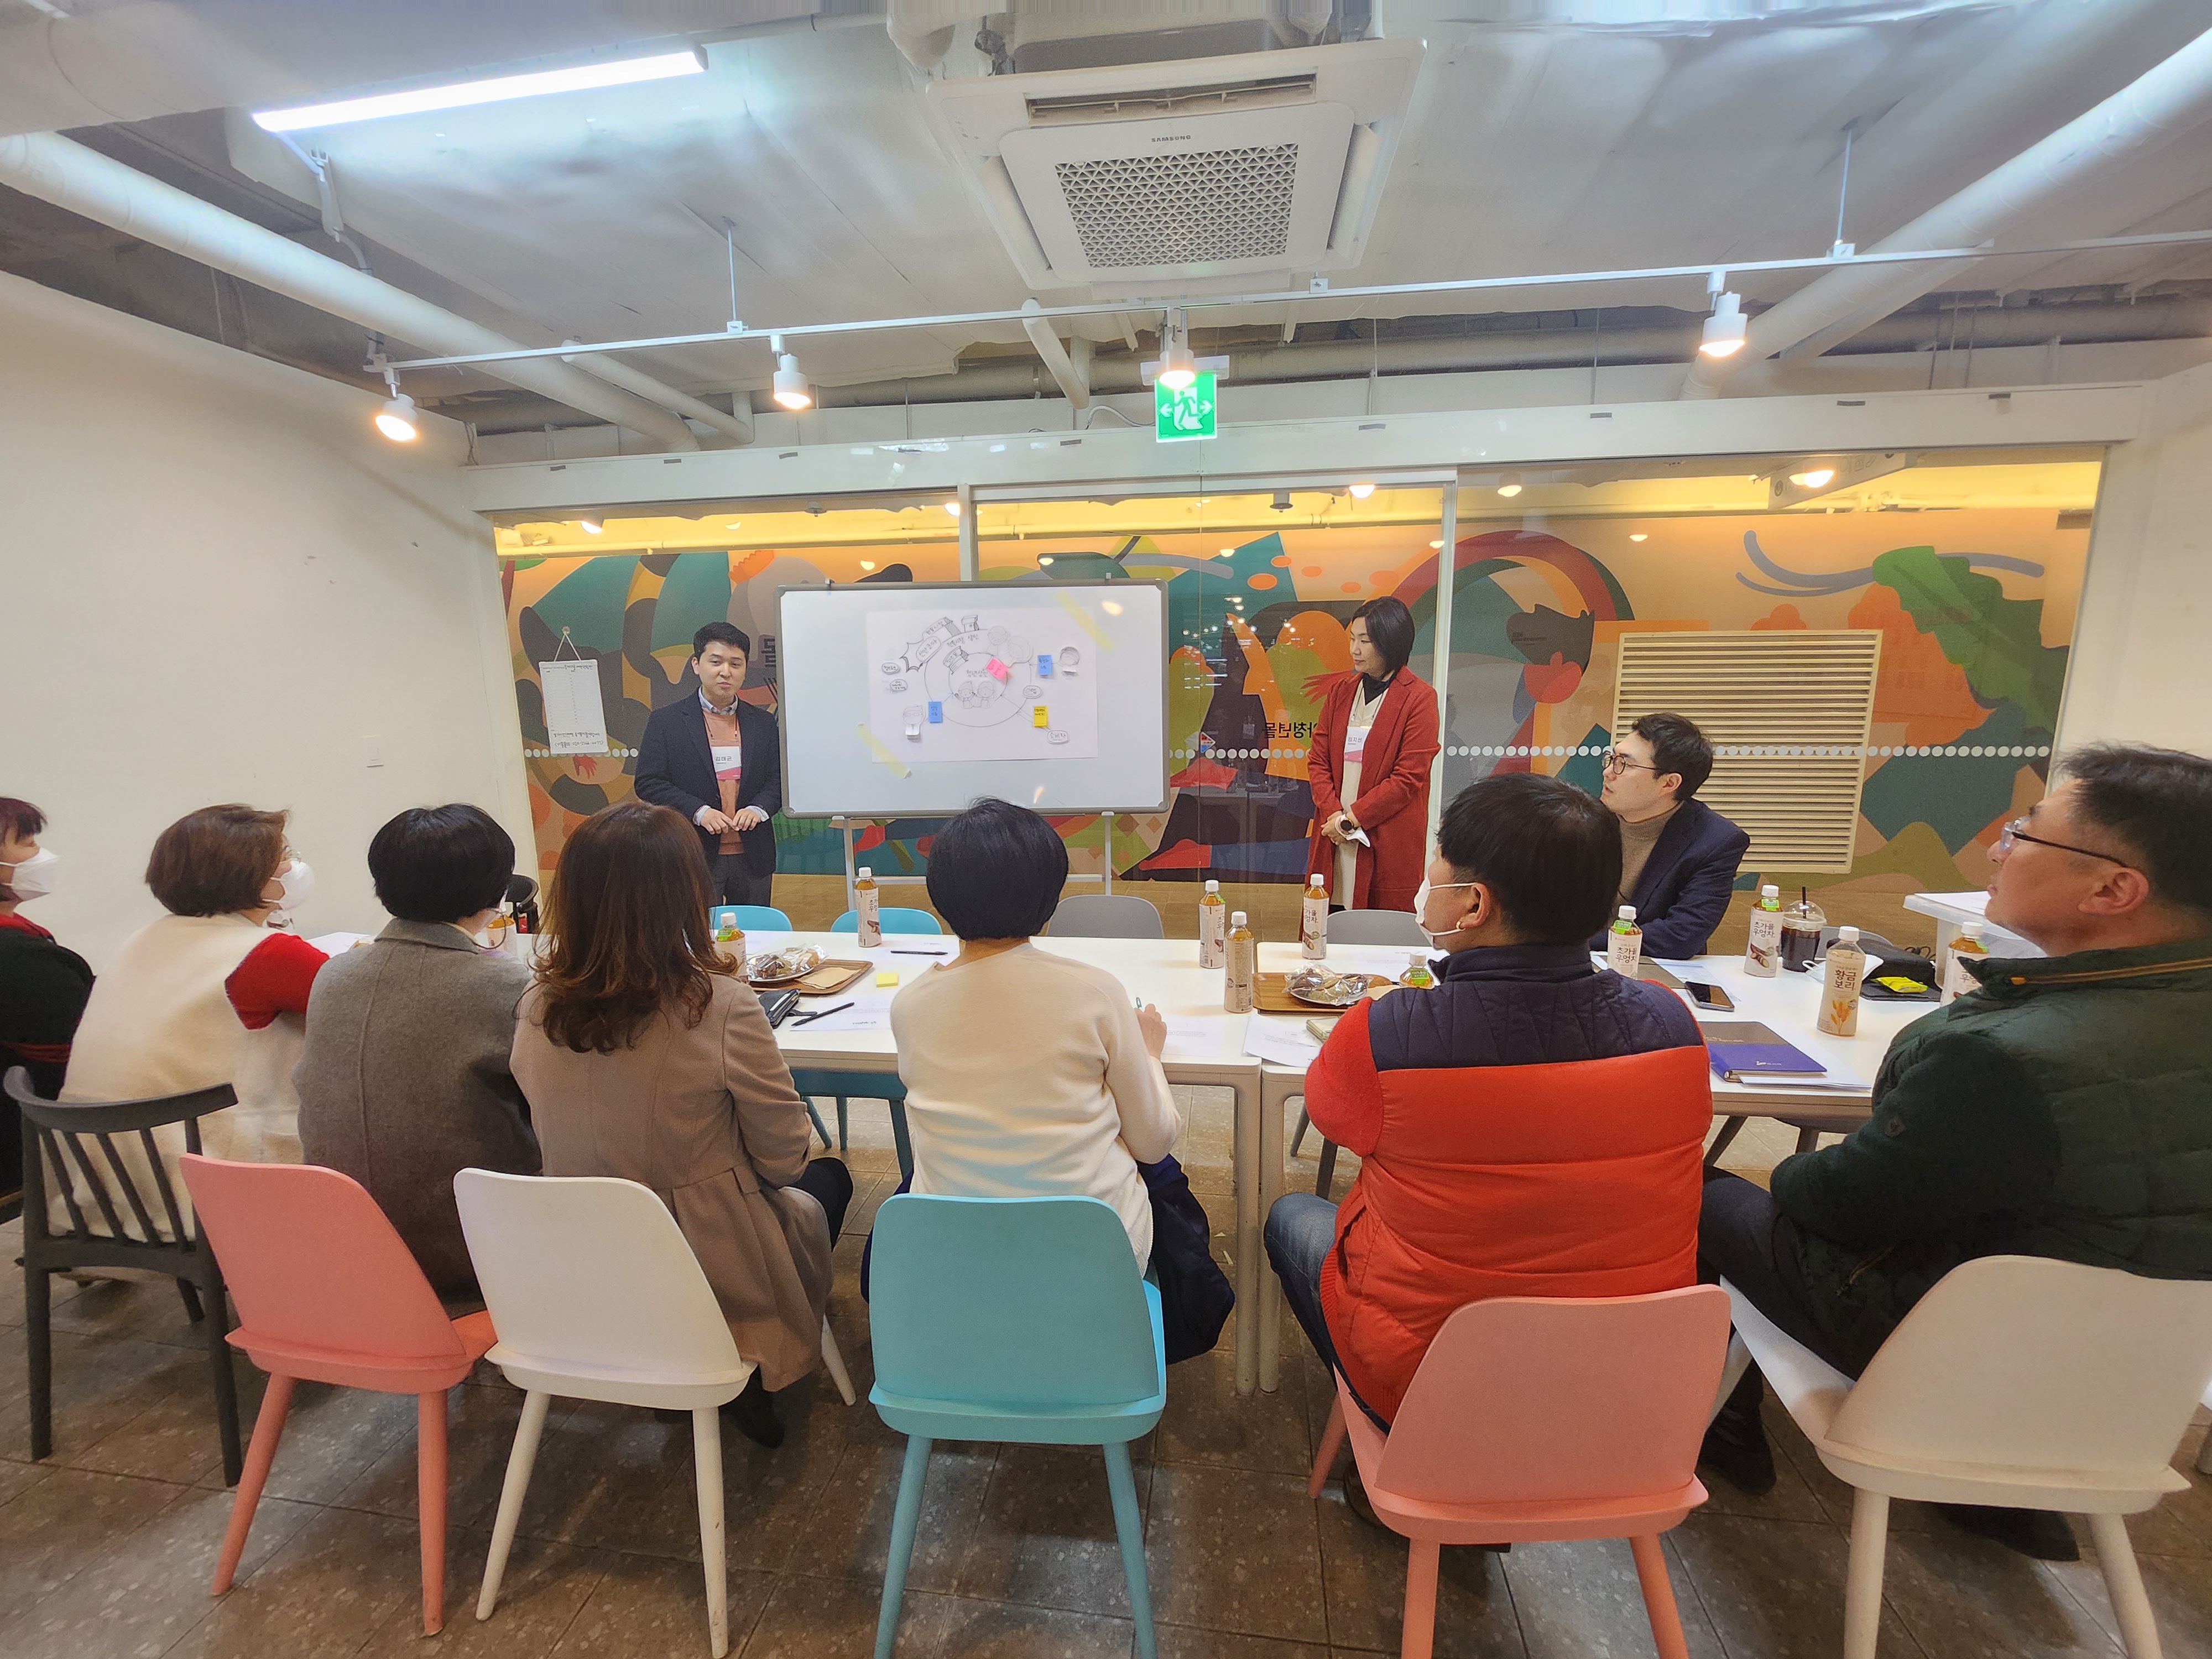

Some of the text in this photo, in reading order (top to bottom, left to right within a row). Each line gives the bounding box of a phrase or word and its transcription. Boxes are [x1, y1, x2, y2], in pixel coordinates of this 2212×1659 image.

[1754, 921, 1775, 930] 초가을
[1752, 928, 1774, 938] 우엉차
[1834, 969, 1857, 981] 황금
[1833, 979, 1856, 992] 보리
